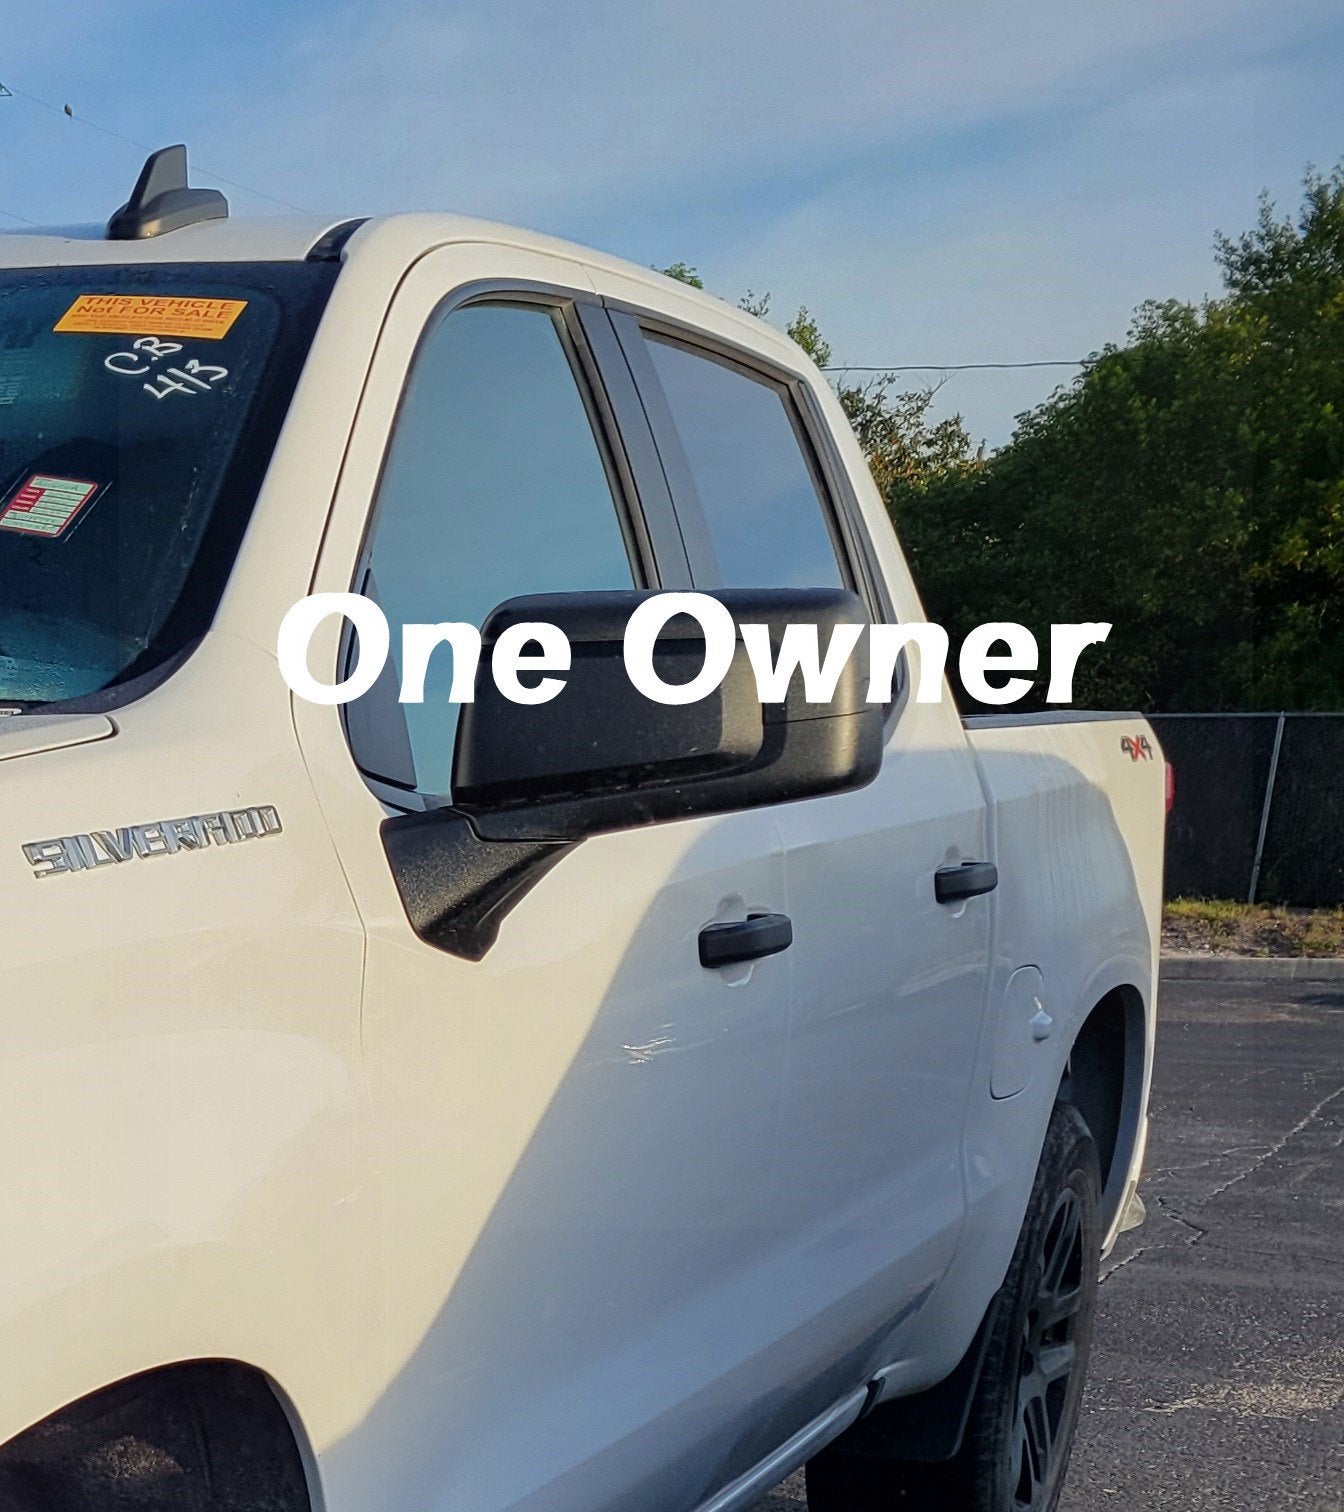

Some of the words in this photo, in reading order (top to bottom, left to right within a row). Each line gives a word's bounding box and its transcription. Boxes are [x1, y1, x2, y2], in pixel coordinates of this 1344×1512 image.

[86, 296, 133, 306] THIS
[141, 298, 236, 310] VEHICLE
[76, 305, 113, 314] Not
[118, 306, 165, 316] FOR
[171, 307, 232, 319] SALE
[21, 804, 283, 879] SILVERADO
